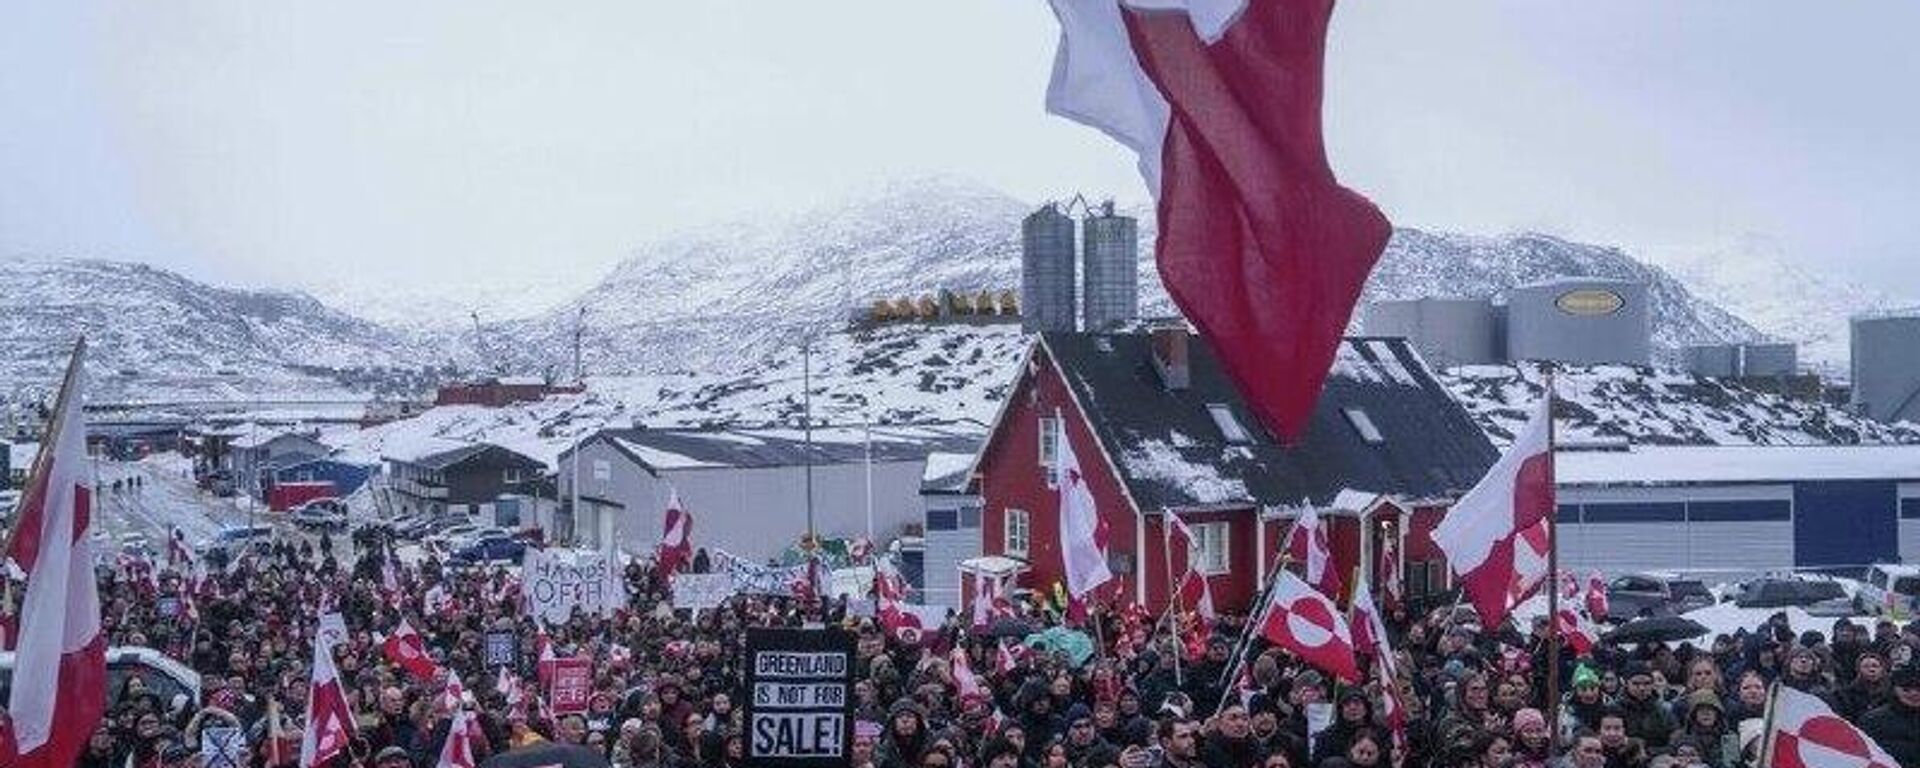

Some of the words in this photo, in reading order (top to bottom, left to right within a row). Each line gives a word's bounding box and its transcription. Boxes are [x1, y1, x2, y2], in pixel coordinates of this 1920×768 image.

[535, 559, 606, 579] HANDS
[759, 655, 845, 673] GREENLAND
[757, 686, 770, 704] IS
[778, 686, 807, 704] NOT
[814, 686, 842, 704] FOR
[755, 715, 839, 754] SALE!
